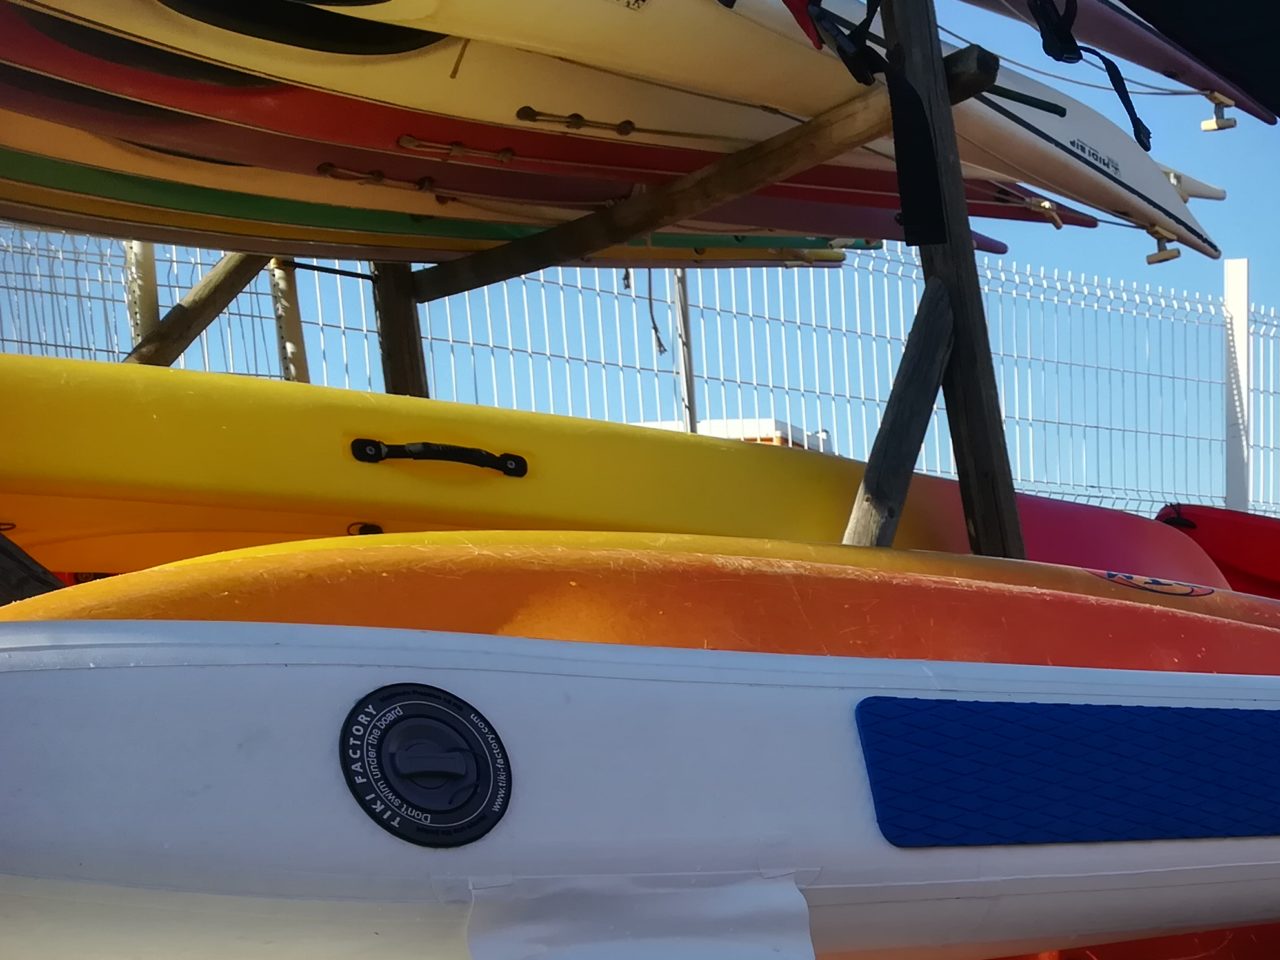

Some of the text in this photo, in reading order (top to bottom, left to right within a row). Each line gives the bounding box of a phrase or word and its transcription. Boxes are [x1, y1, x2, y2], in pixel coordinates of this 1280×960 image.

[349, 703, 401, 828] TIKI FACTORY
[366, 706, 432, 825] Don't swim under the board
[469, 712, 508, 812] www.tiki-factory.com
